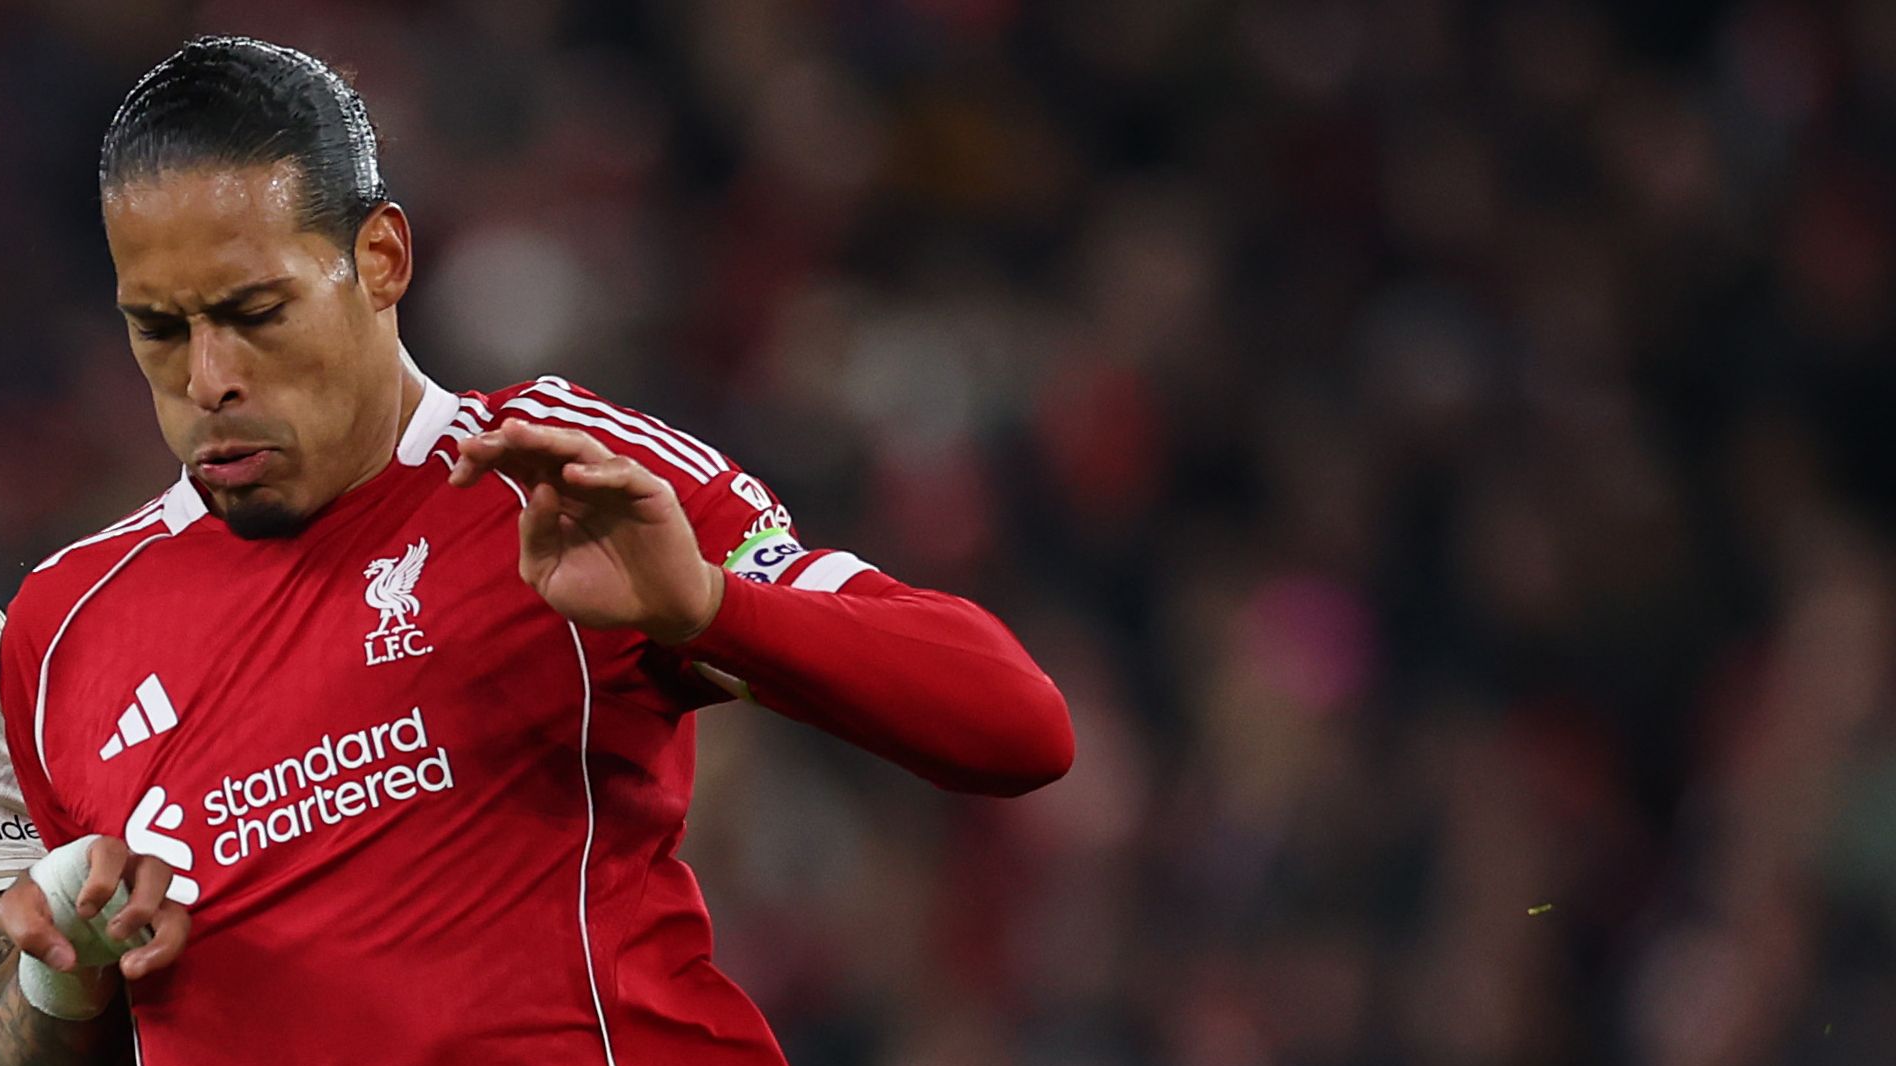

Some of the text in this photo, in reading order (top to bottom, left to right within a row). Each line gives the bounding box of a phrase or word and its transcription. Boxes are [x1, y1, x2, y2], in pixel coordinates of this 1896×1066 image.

[364, 630, 434, 666] L.F.C.
[204, 706, 428, 826] standard
[213, 747, 454, 866] chartered
